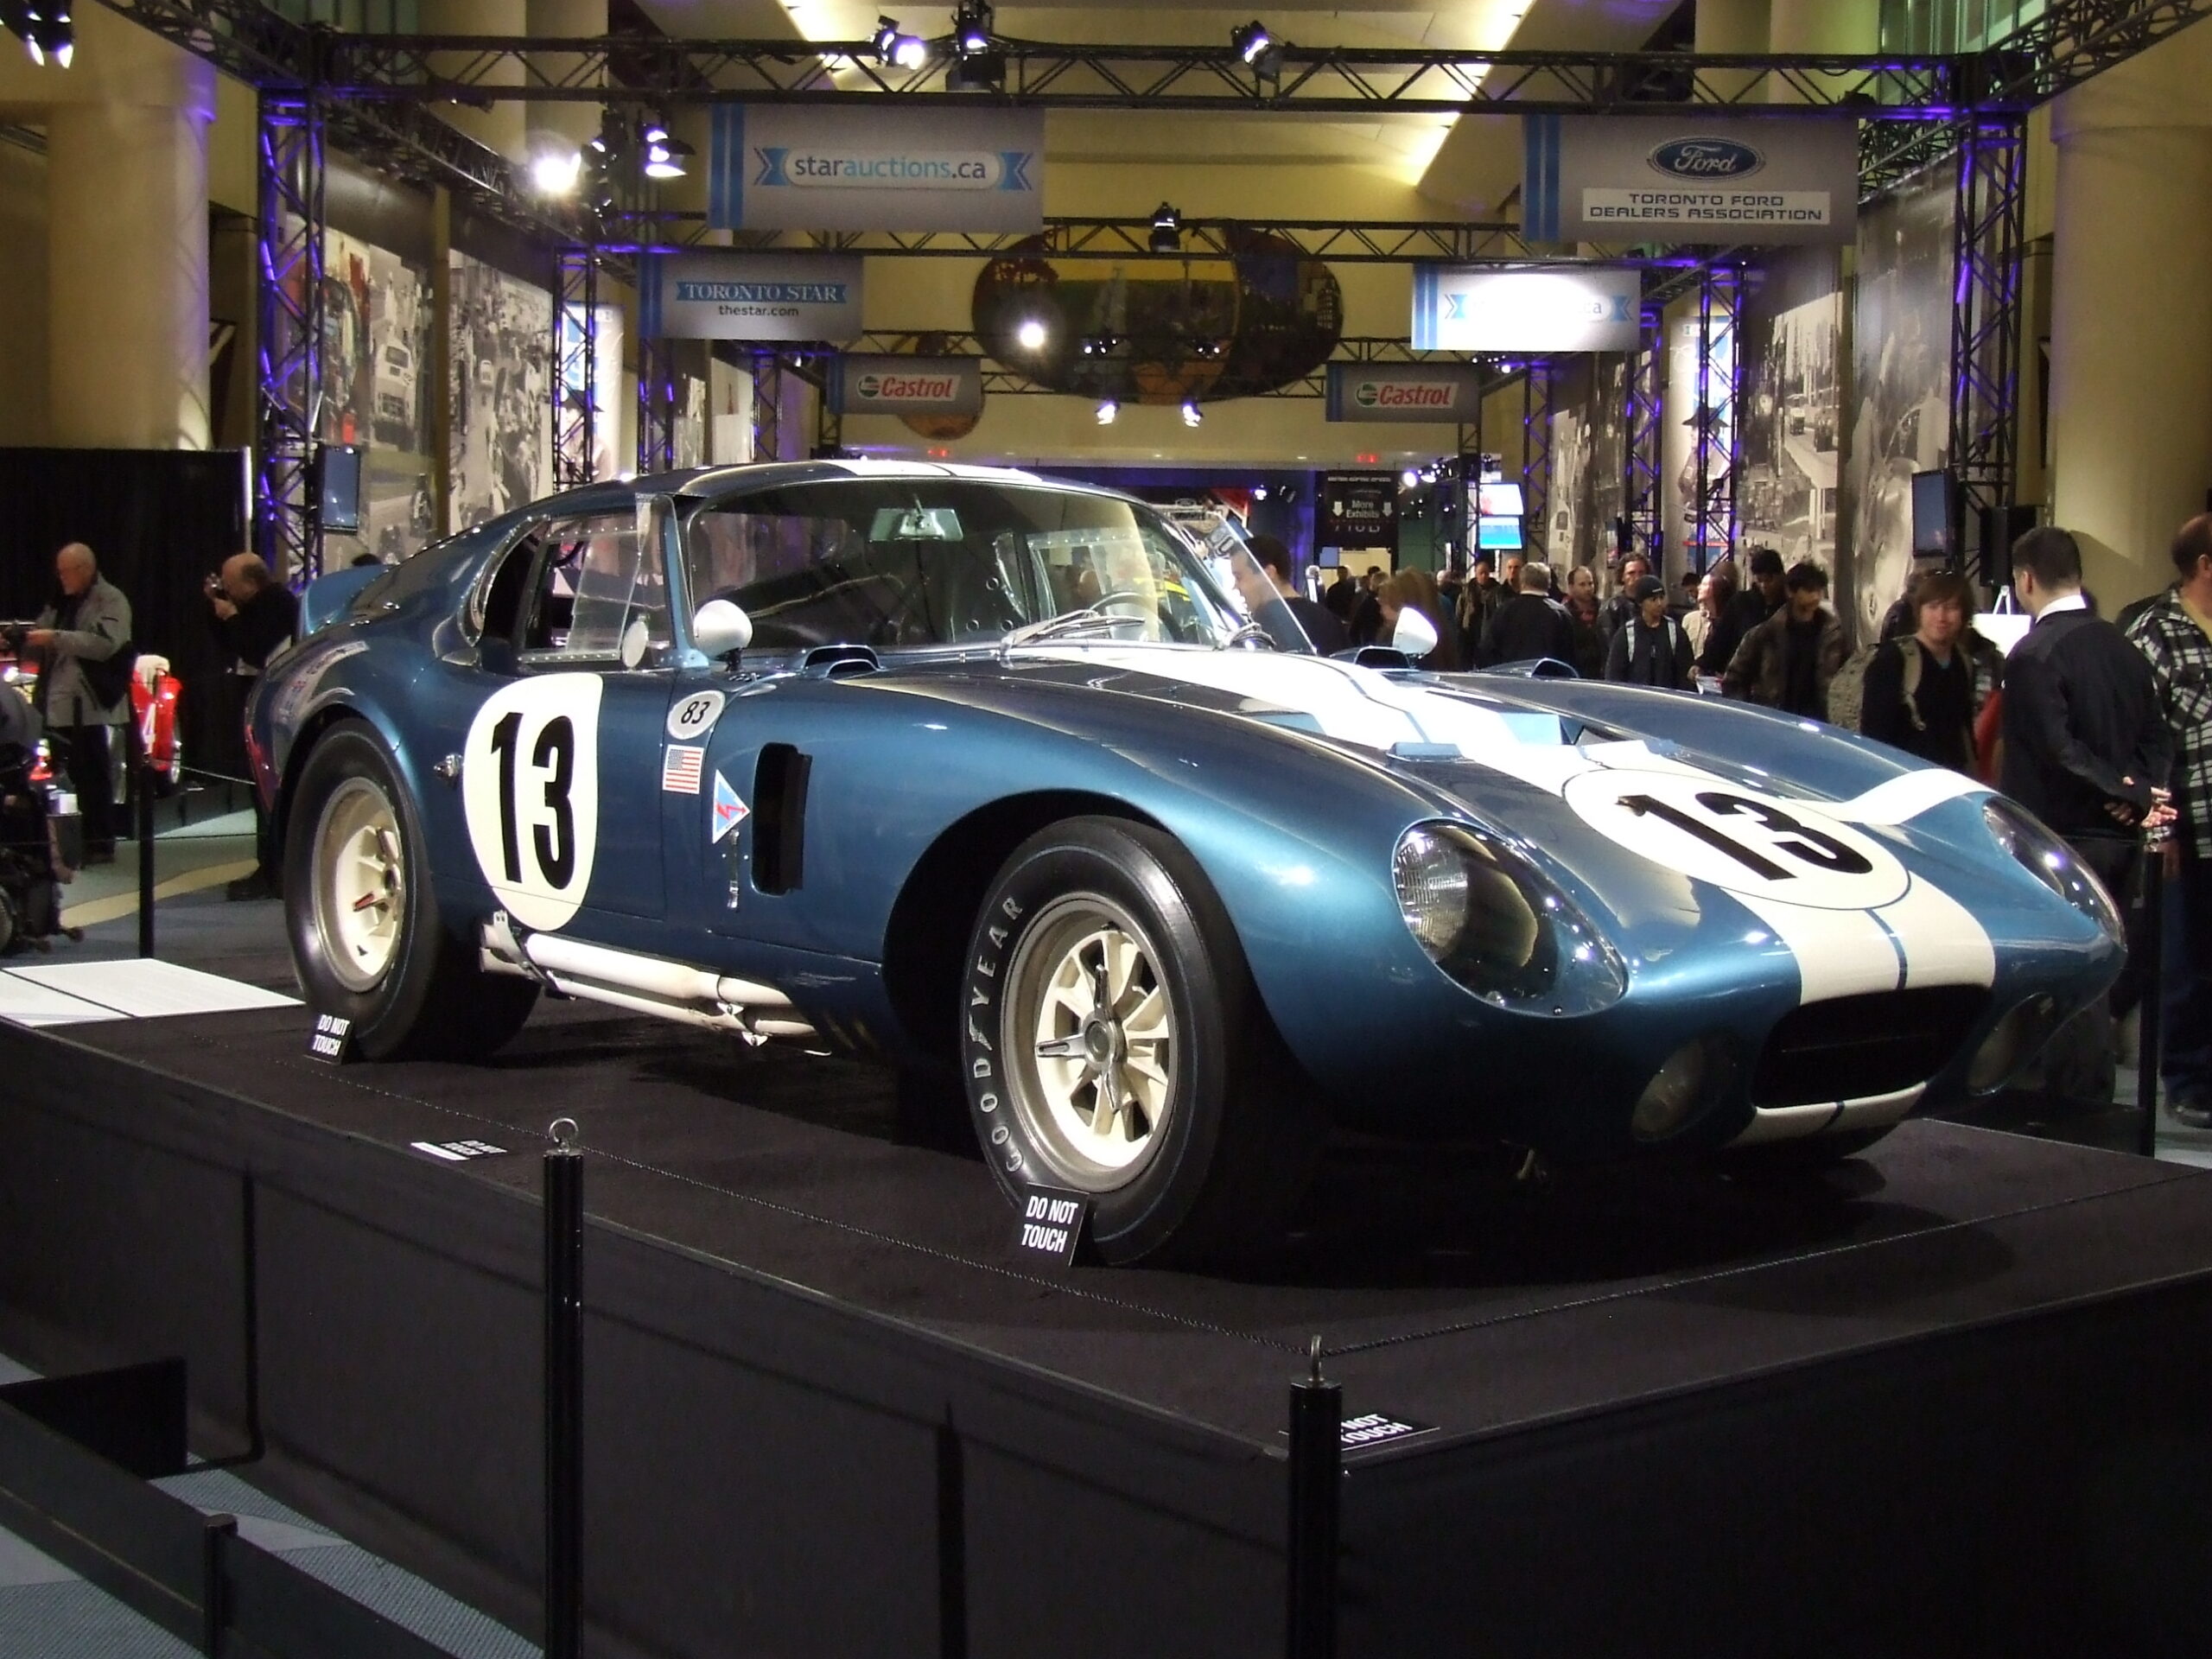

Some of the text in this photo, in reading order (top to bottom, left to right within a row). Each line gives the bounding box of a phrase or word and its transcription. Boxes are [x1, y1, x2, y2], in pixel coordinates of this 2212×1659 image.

[794, 155, 987, 180] starauctions.ca
[1674, 145, 1738, 173] Ford
[1629, 193, 1783, 207] TORONTO FORD
[1590, 207, 1822, 220] DEALERS ASSOCIATION
[684, 283, 837, 302] TORONTO STAR
[719, 305, 799, 316] thestar.com
[881, 377, 953, 397] Castrol
[1379, 385, 1452, 405] Castrol
[681, 701, 711, 725] 83
[491, 711, 575, 890] 13
[1615, 791, 1873, 880] 13
[318, 1014, 351, 1036] DO NOT
[969, 896, 1024, 1173] GOODYEAR
[312, 1034, 341, 1057] TOUCH
[1026, 1195, 1079, 1224] DO NOT
[1021, 1224, 1068, 1253] TOUCH
